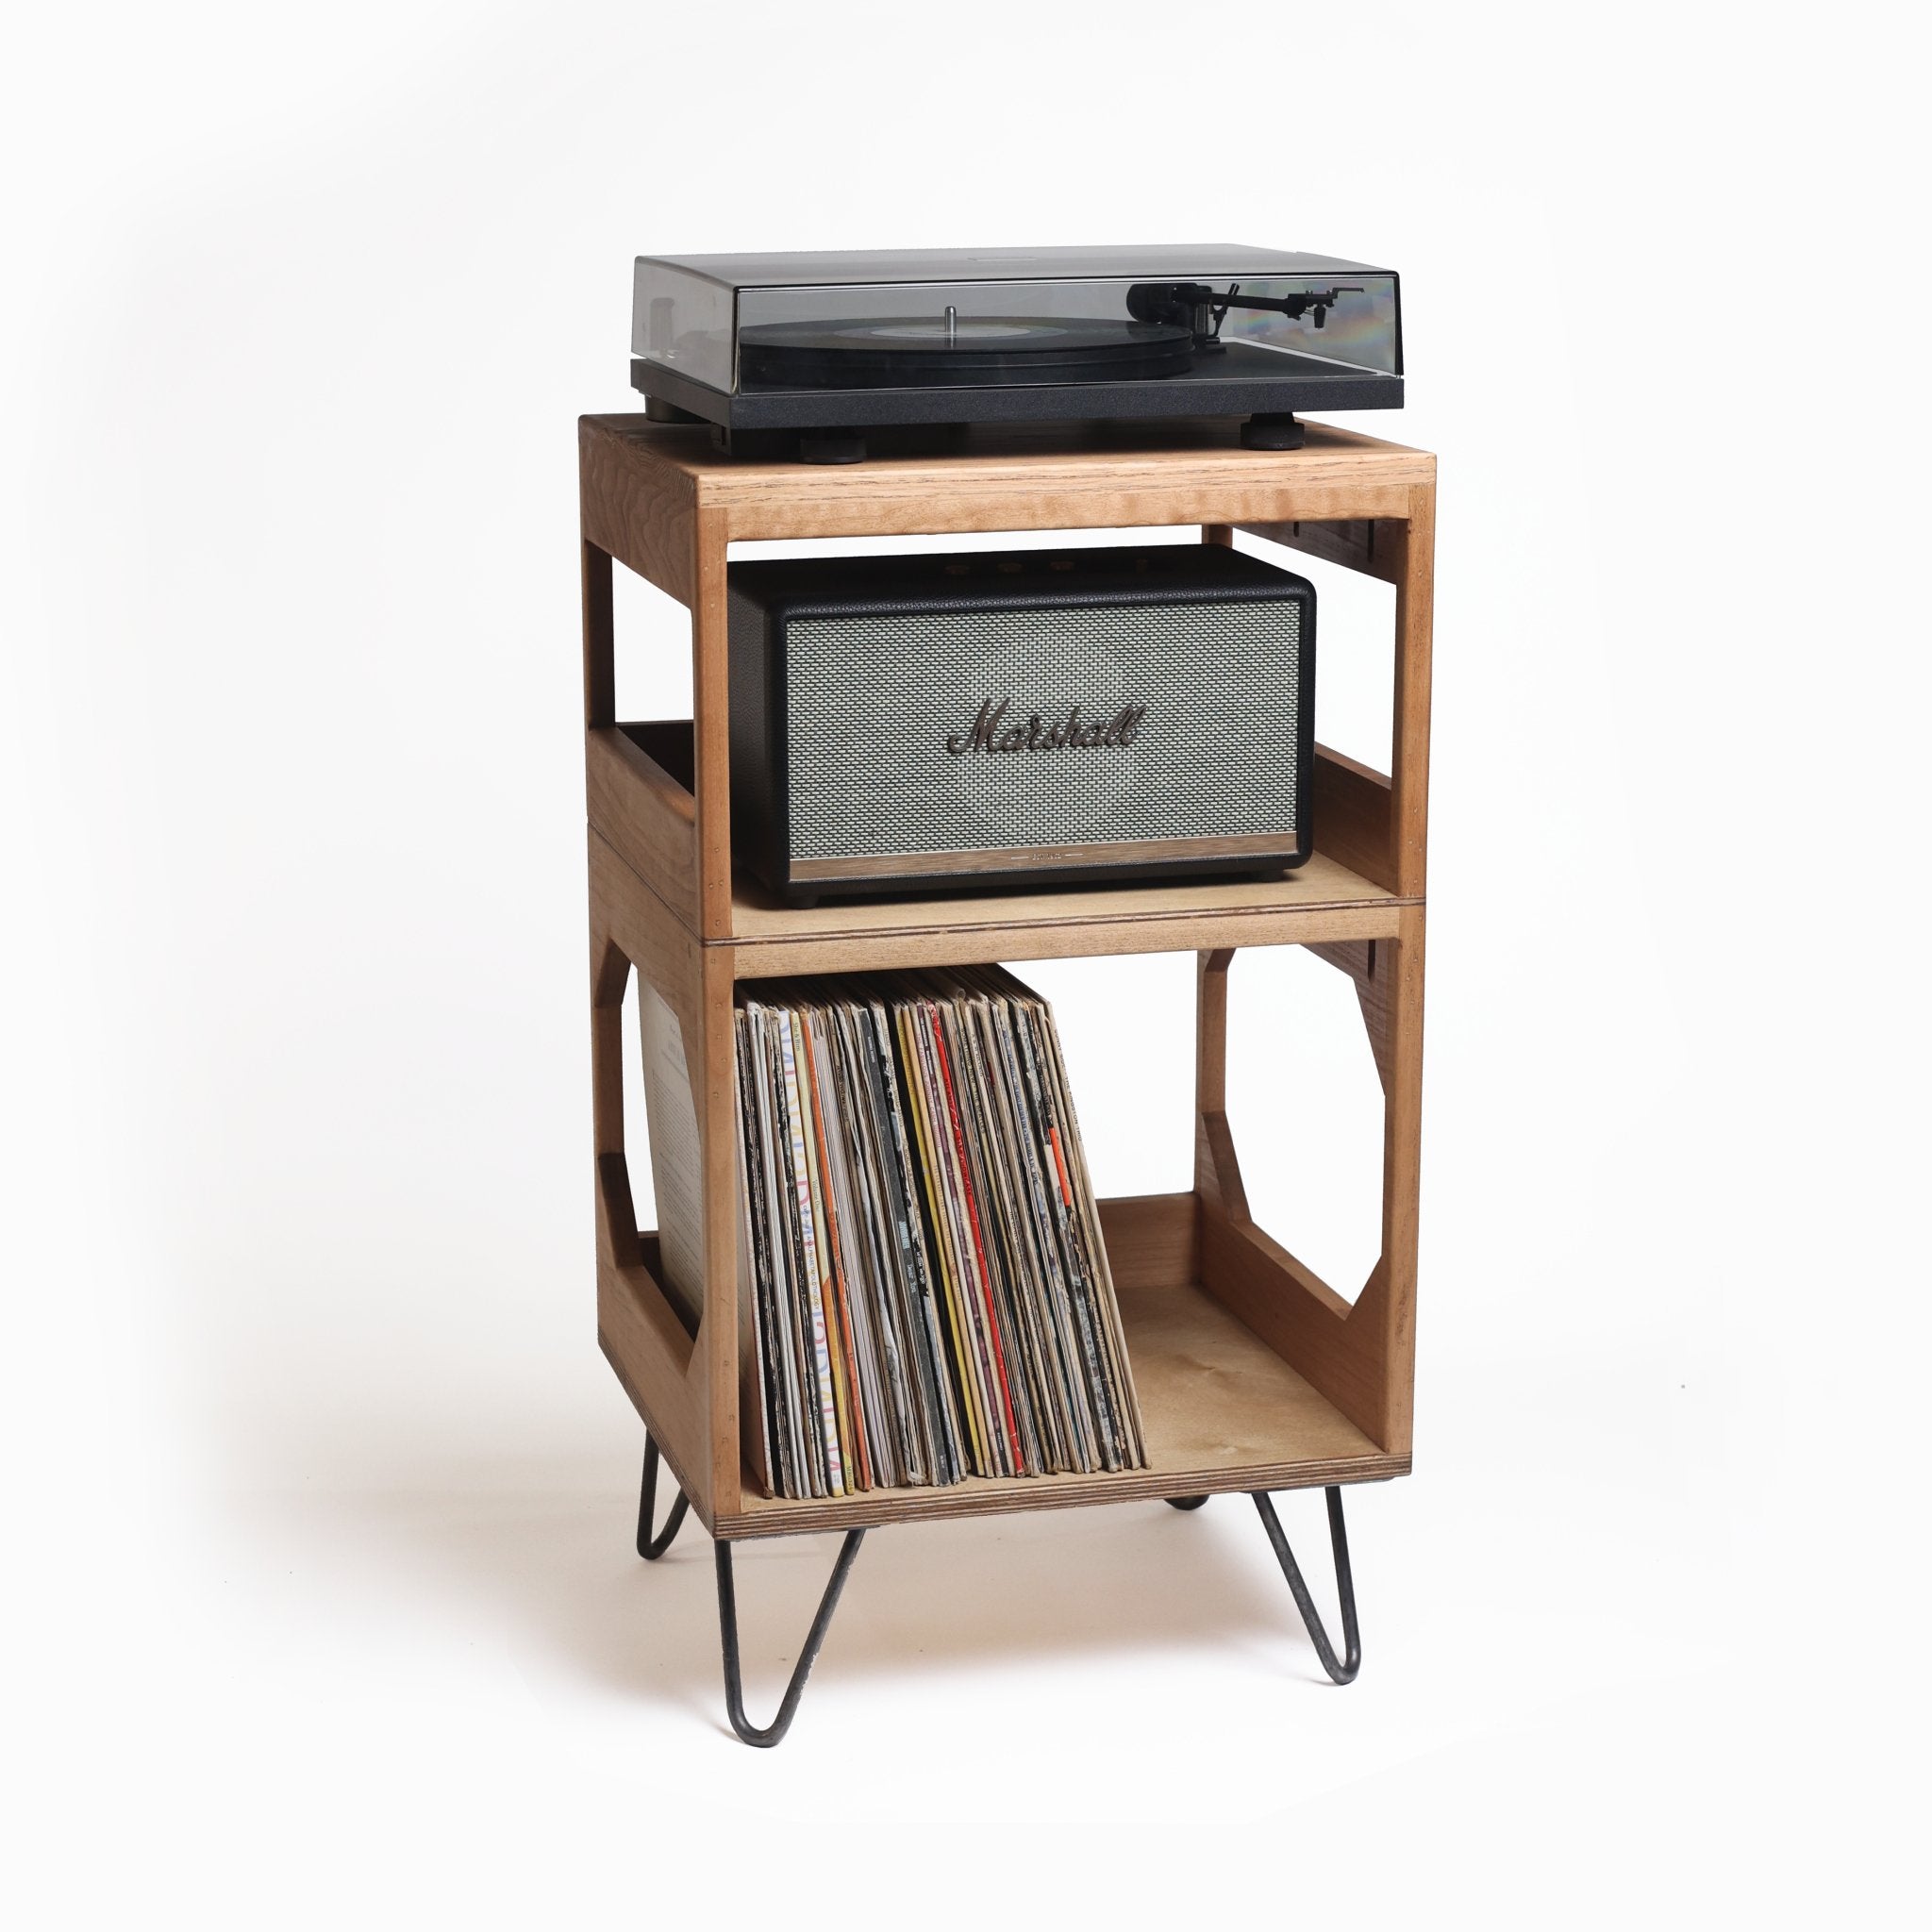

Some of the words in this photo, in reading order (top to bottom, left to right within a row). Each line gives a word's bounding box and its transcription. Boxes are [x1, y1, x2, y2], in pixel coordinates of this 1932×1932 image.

[947, 697, 1147, 752] Marshall
[959, 1027, 972, 1066] SOMETHING
[968, 1067, 976, 1084] NEW
[974, 1104, 987, 1134] BEATLES
